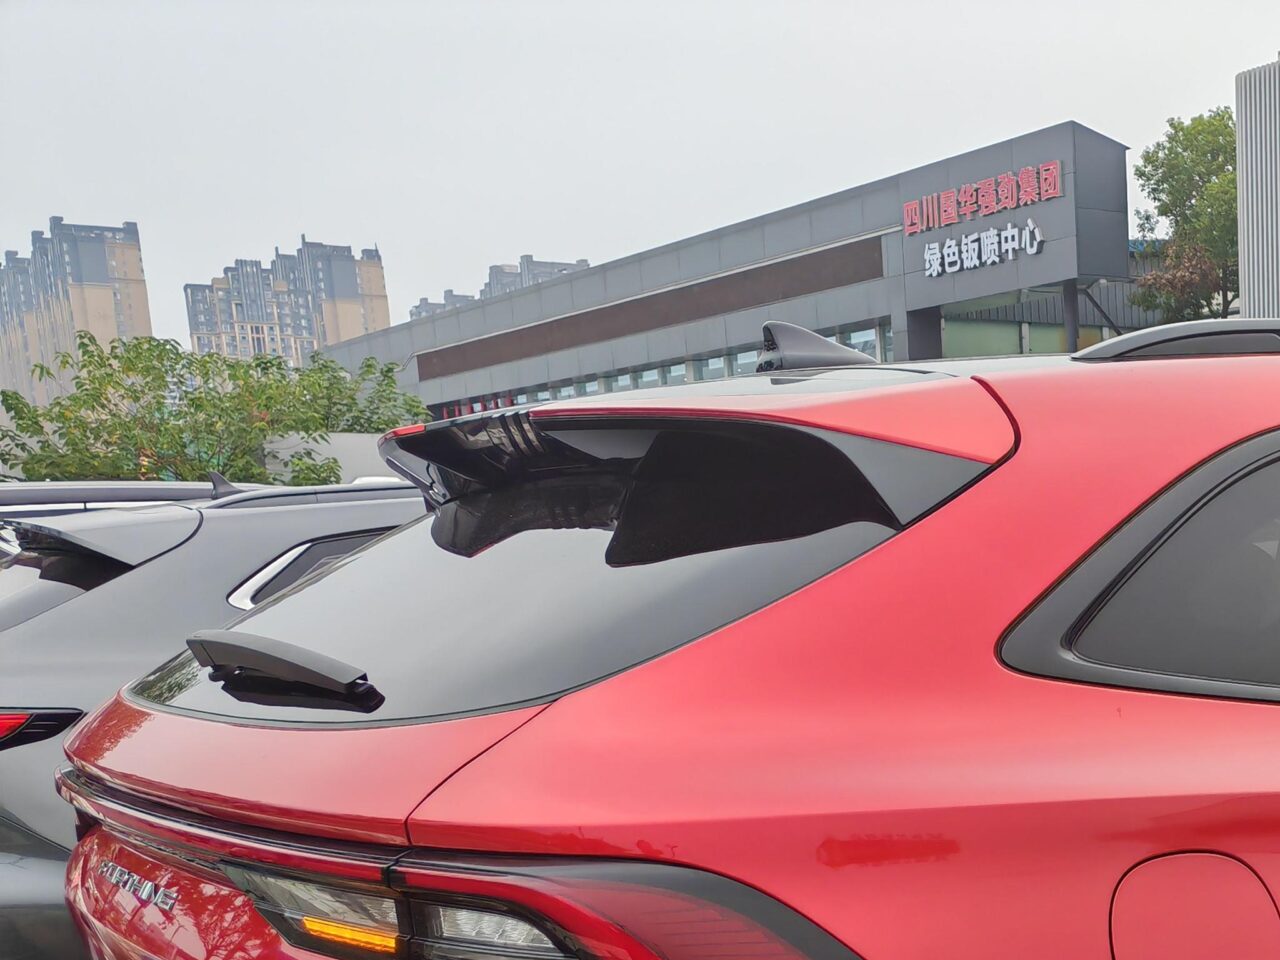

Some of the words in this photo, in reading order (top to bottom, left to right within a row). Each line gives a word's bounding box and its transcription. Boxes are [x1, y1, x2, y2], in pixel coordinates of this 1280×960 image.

[924, 218, 1045, 277] 绿色钣喷中心
